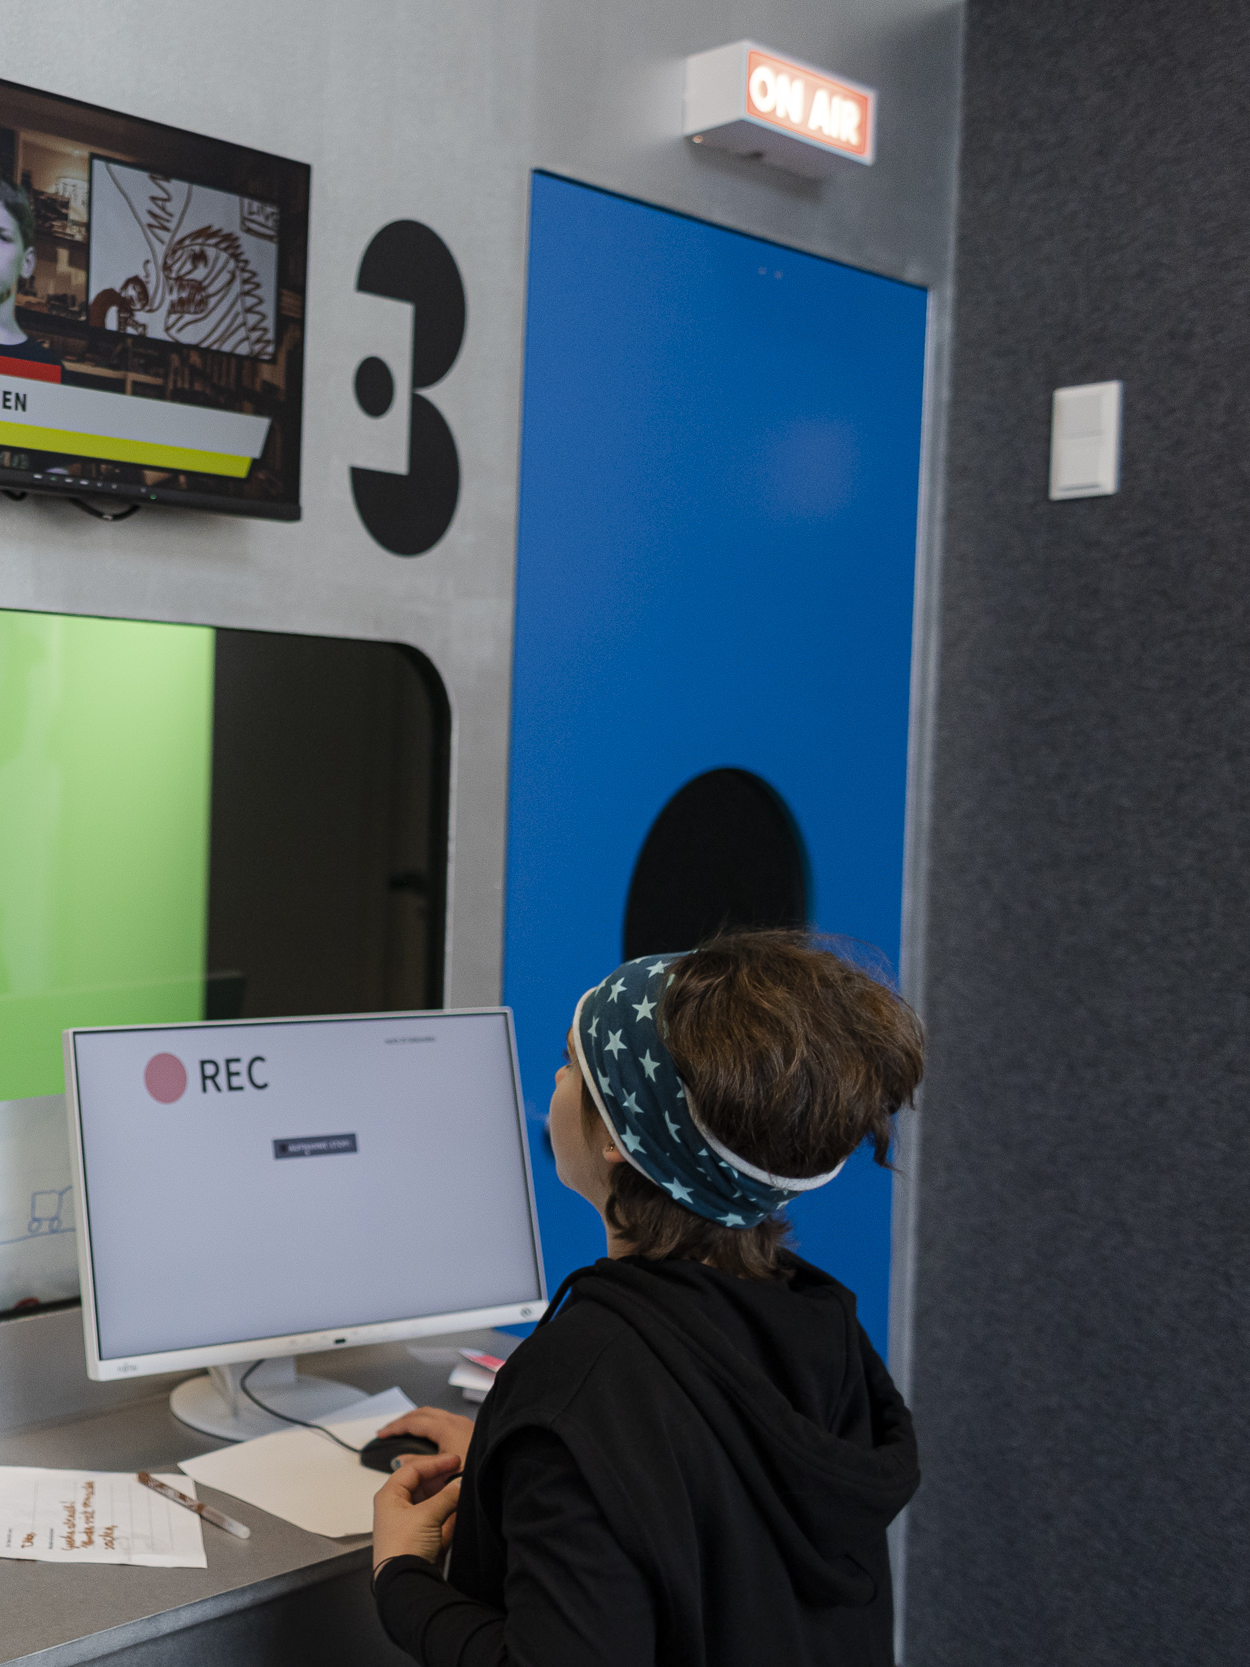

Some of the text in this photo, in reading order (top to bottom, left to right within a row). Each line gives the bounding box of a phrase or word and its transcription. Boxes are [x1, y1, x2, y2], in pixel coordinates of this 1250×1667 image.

[749, 66, 861, 146] ON AIR
[349, 219, 466, 557] 3
[199, 1056, 269, 1094] REC
